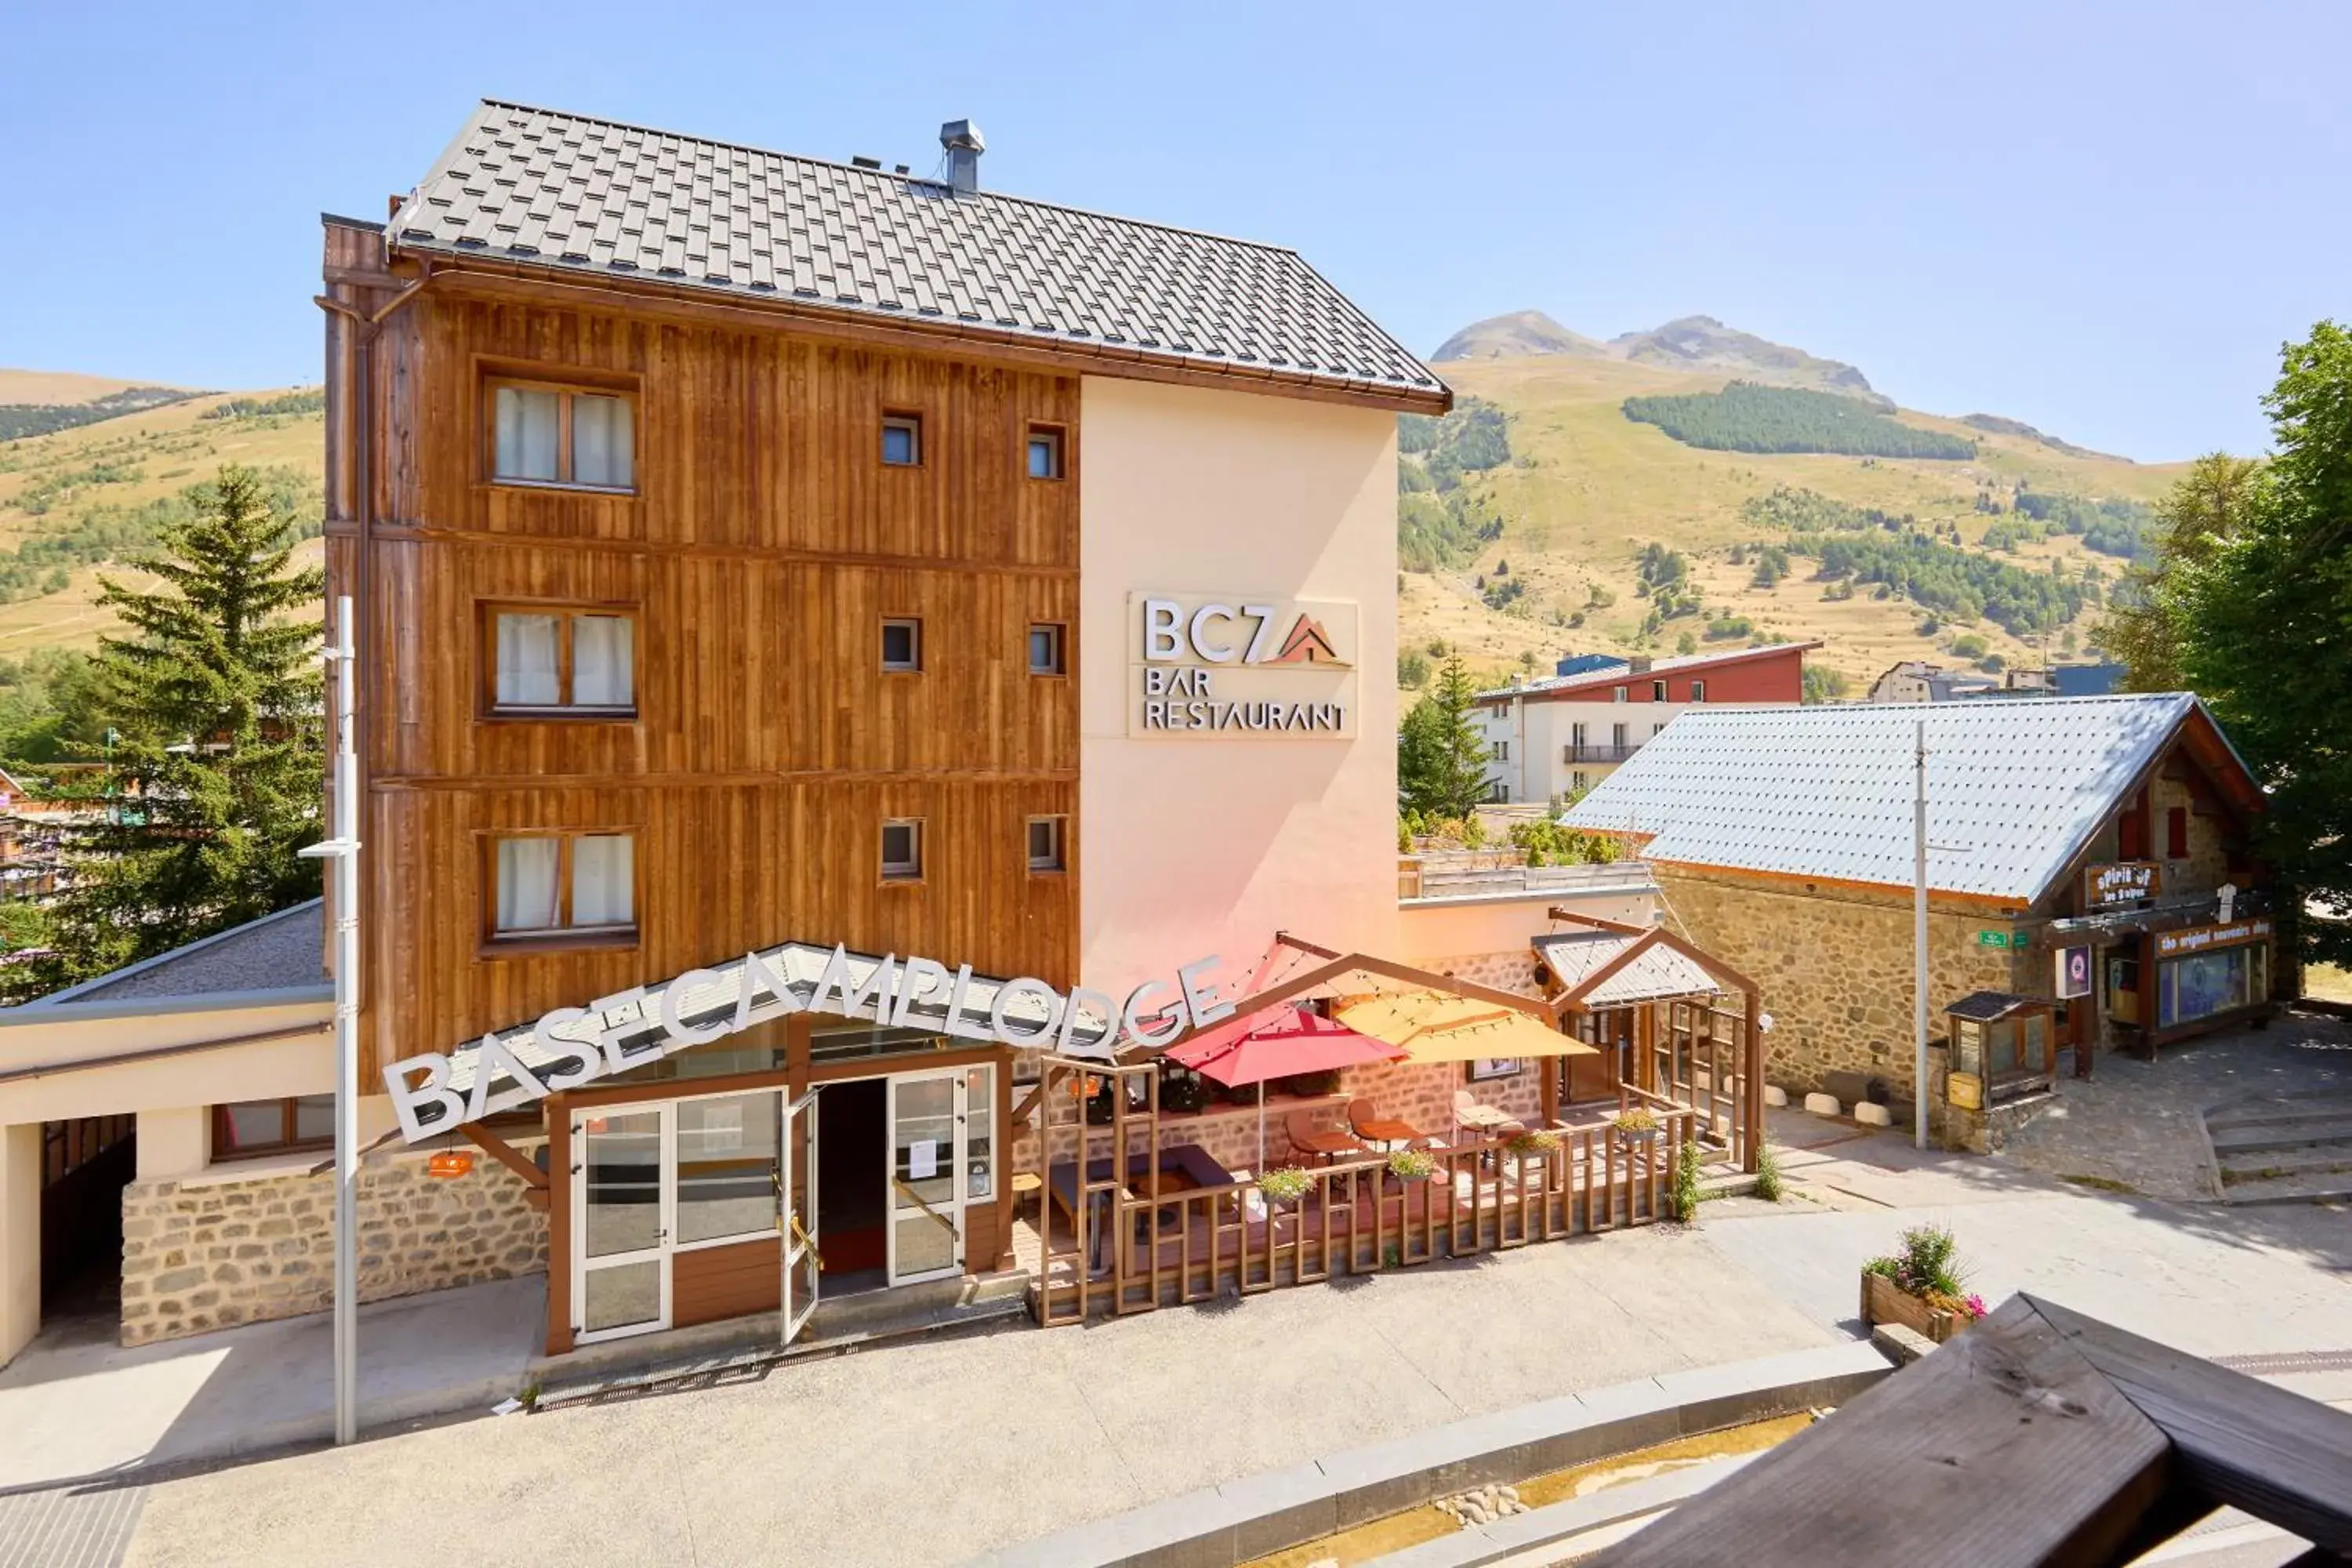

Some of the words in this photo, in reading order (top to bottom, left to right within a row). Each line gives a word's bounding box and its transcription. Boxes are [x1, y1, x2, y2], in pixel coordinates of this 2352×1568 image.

[1144, 600, 1276, 663] BC7
[1144, 668, 1210, 697] BAR
[1144, 701, 1347, 731] RESTAURANT
